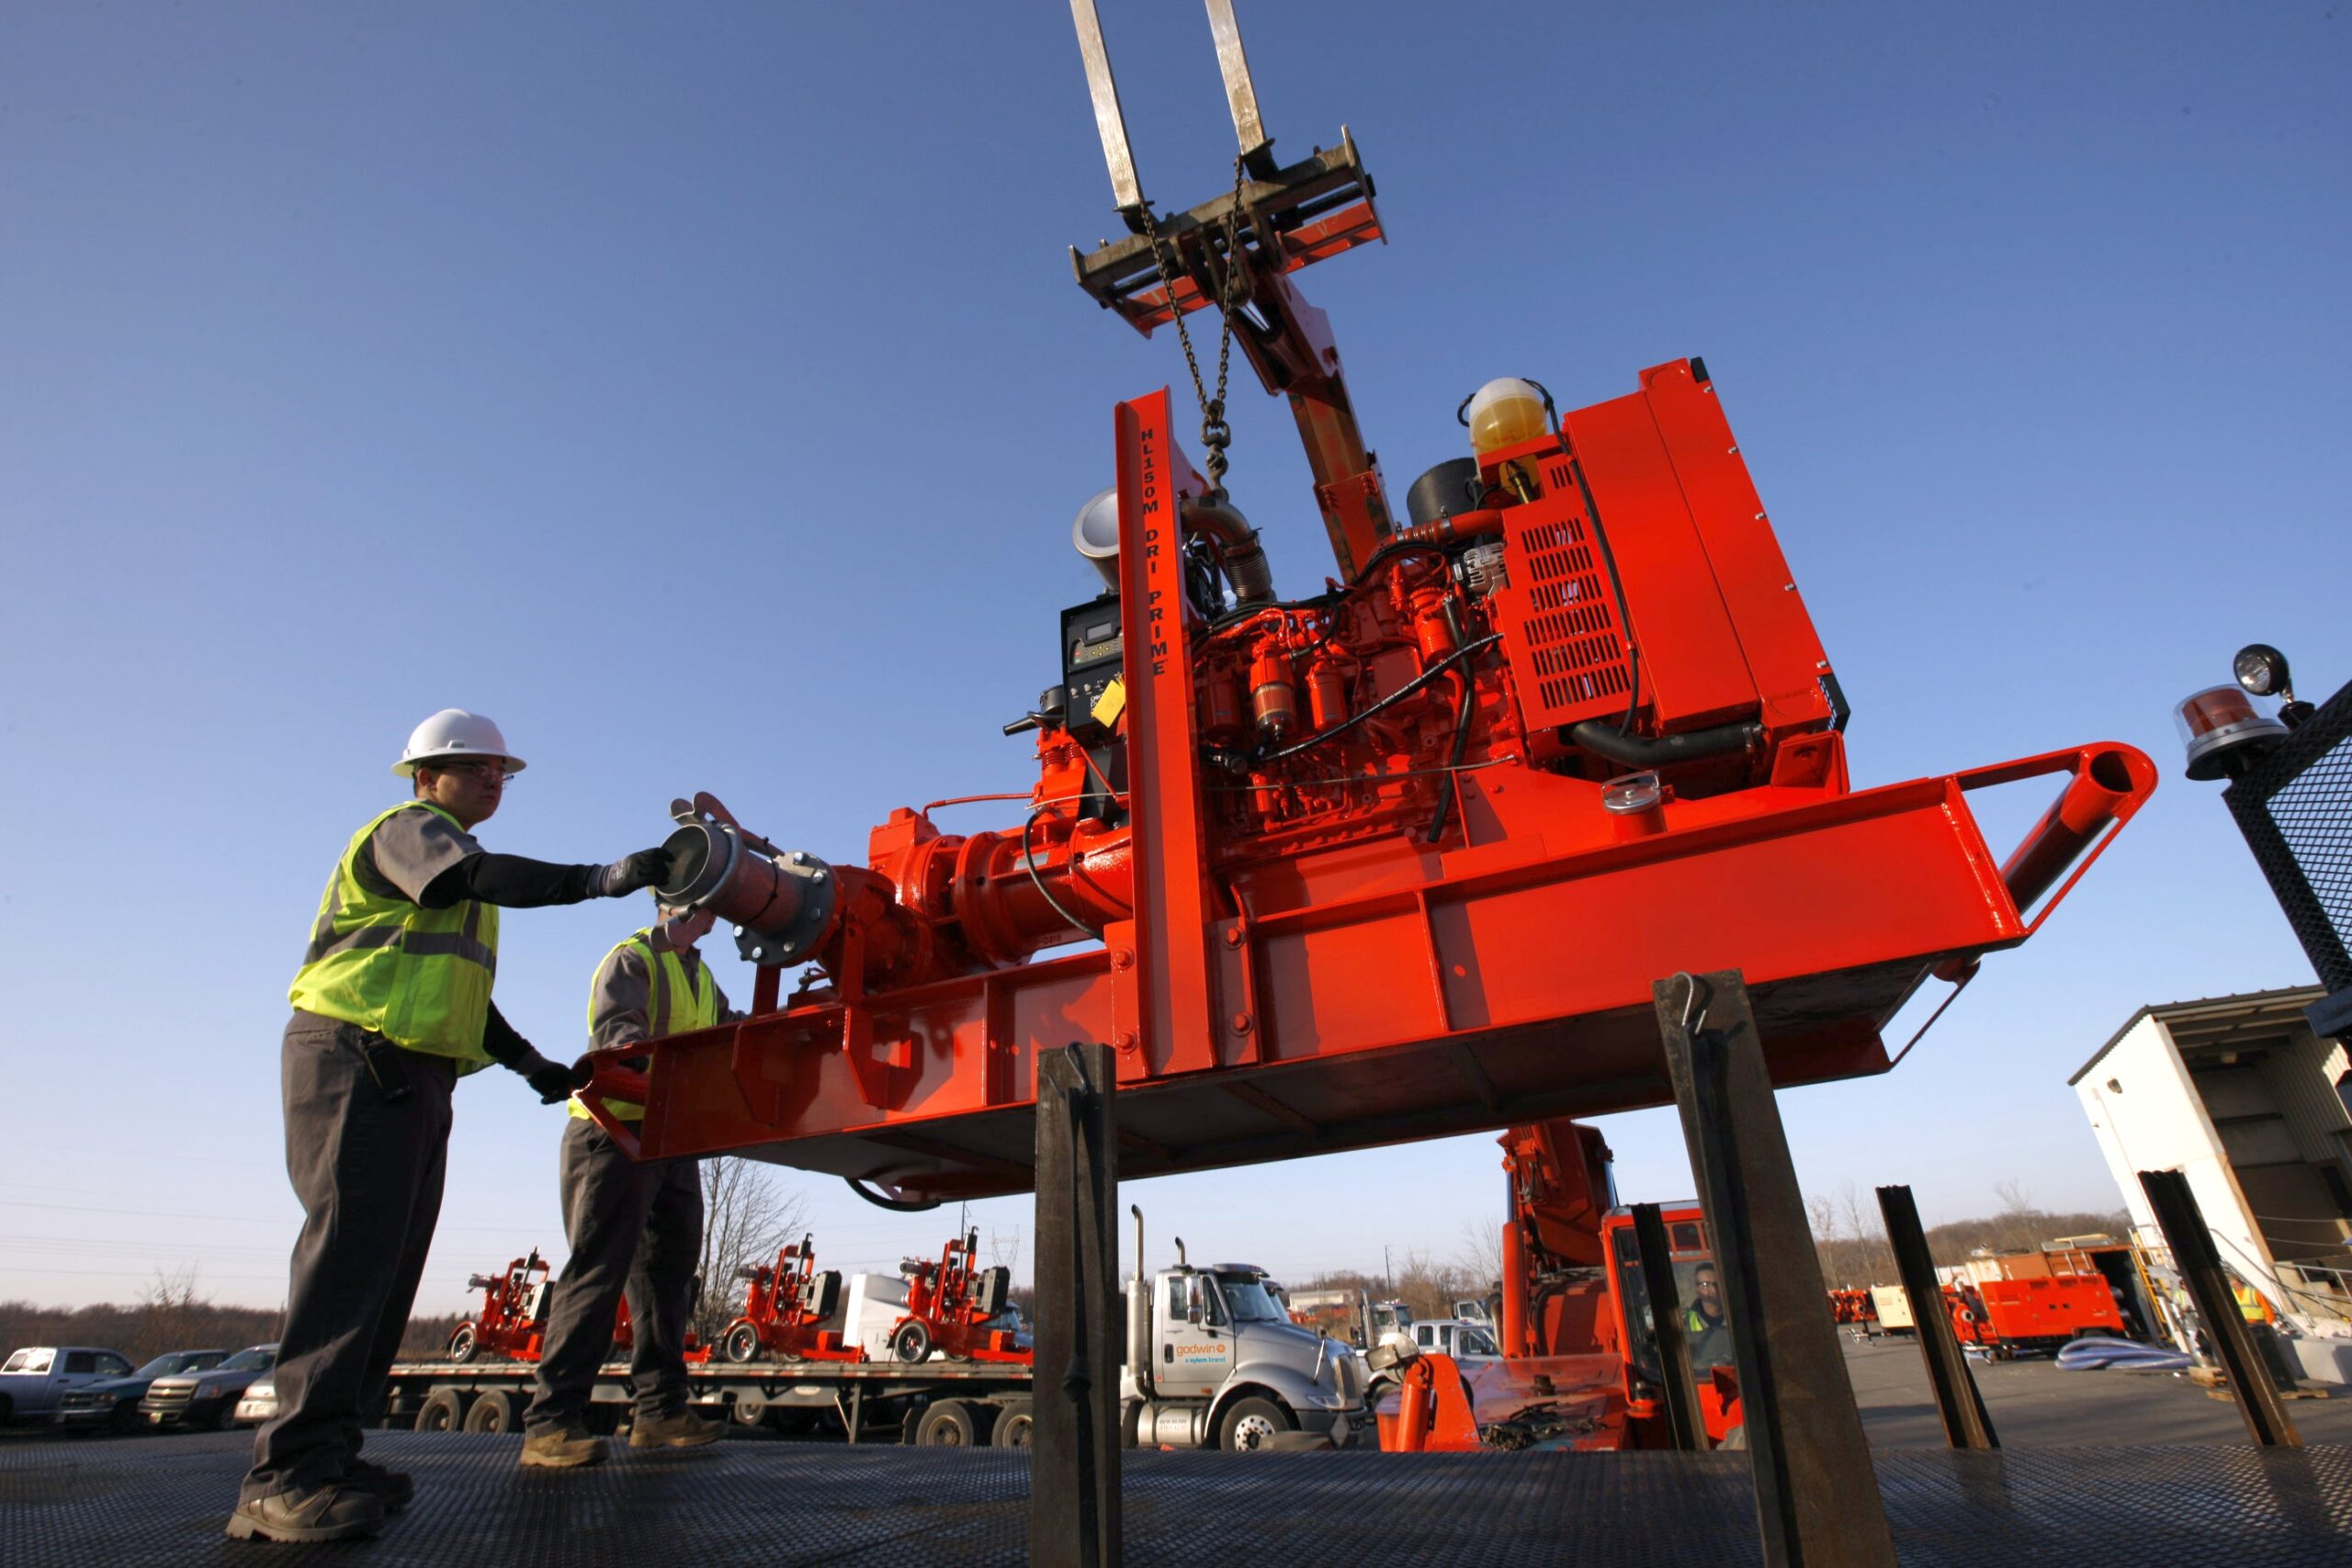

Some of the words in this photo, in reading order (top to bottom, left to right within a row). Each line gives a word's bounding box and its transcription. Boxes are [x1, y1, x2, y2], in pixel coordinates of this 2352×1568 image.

[1141, 429, 1159, 515] HL150M
[1146, 530, 1159, 574] DRI
[1148, 591, 1168, 676] PRIME
[1176, 1344, 1215, 1356] godwin
